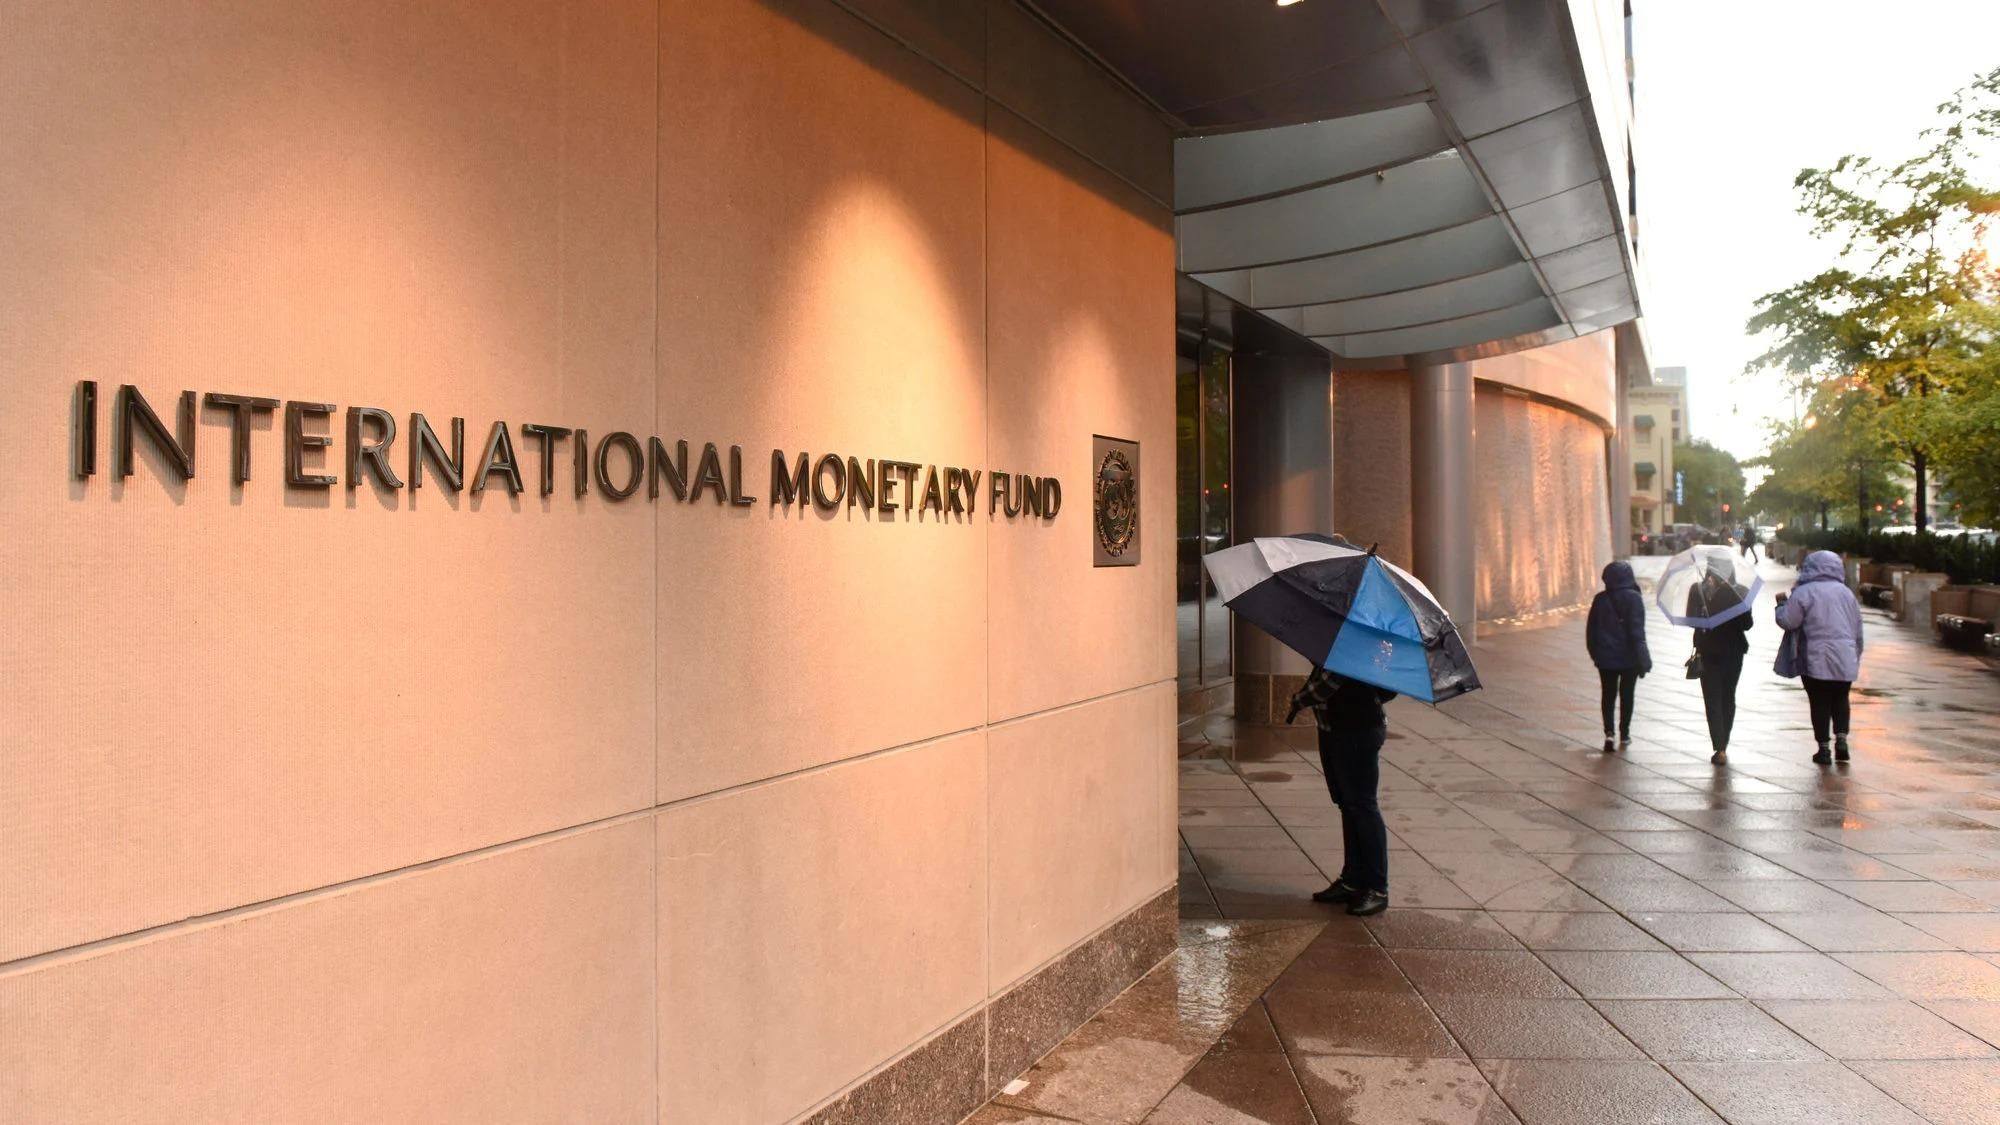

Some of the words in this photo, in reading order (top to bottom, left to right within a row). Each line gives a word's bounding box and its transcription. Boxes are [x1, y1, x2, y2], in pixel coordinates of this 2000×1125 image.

[75, 380, 757, 504] INTERNATIONAL
[770, 449, 982, 514] MONETARY
[989, 470, 1061, 519] FUND
